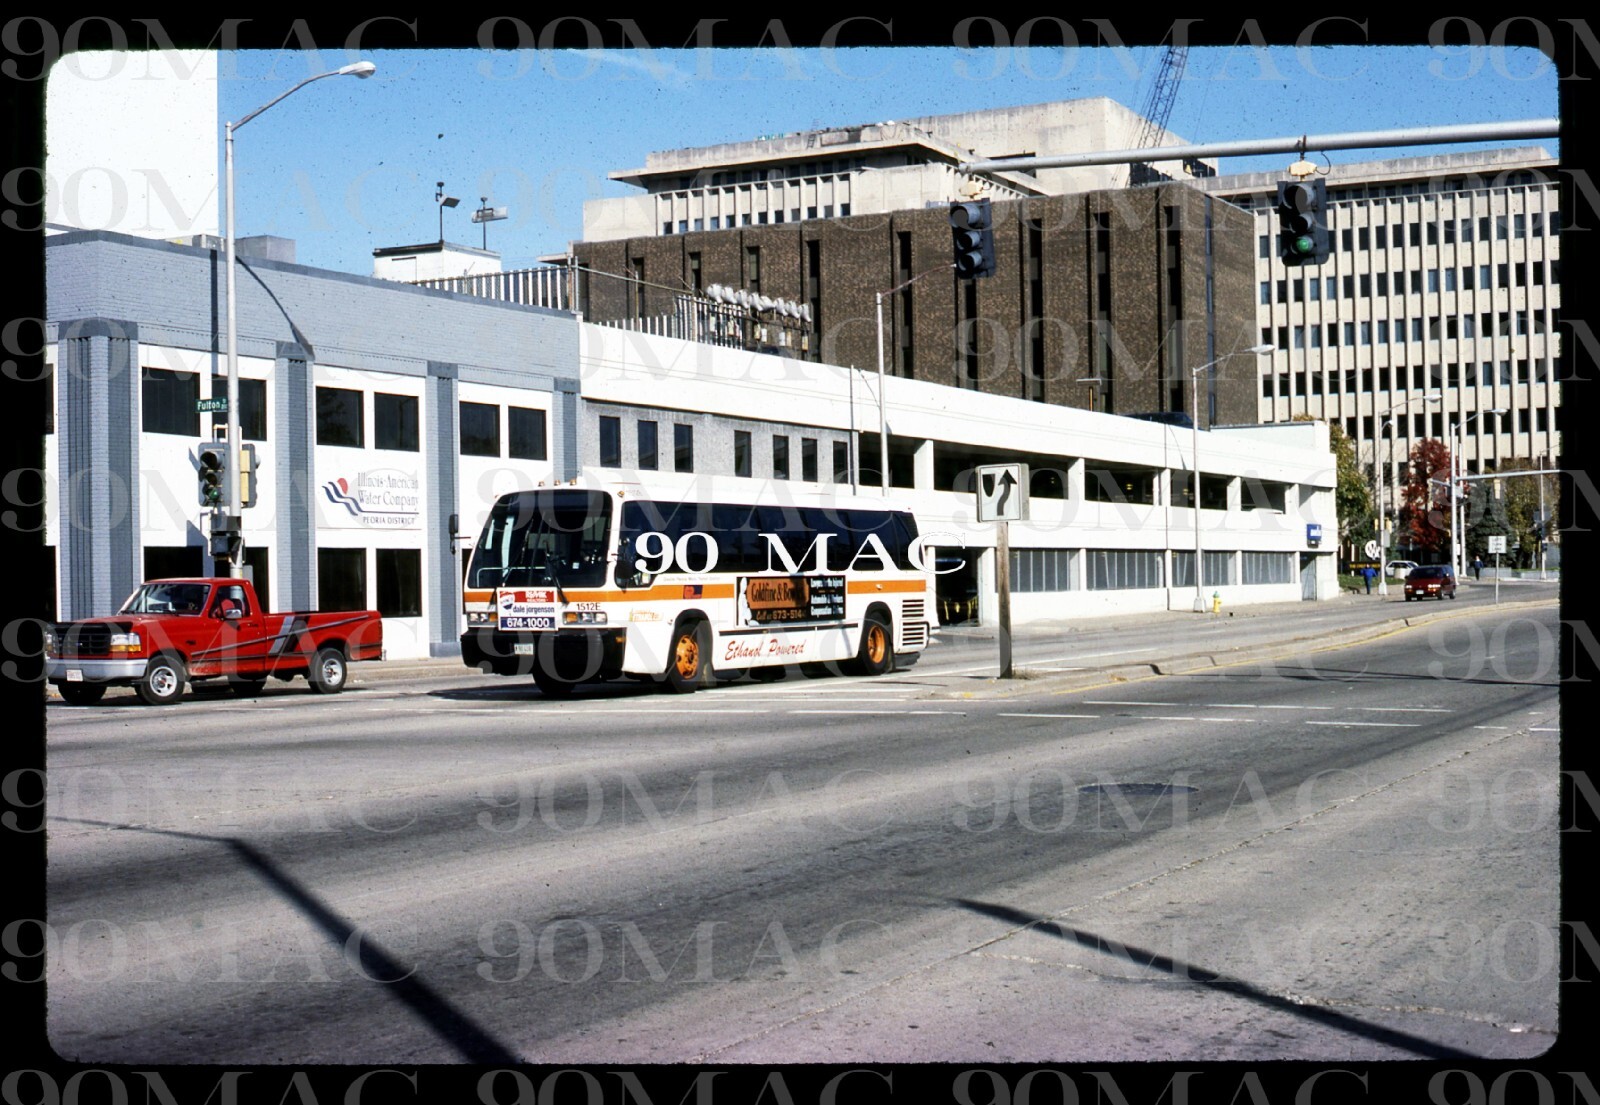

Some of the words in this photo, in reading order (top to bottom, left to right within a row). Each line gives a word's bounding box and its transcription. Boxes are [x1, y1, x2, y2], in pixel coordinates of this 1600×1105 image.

[197, 401, 221, 410] Fulton
[358, 490, 381, 505] Water
[382, 491, 419, 512] Company
[363, 516, 386, 525] PEORIA
[387, 517, 415, 526] DISTRICT
[751, 583, 777, 602] Goldfine
[777, 583, 783, 602] &
[513, 605, 526, 613] dale
[526, 605, 555, 614] jorgenson
[576, 602, 602, 611] 1512E
[725, 640, 764, 661] Ethanol
[768, 638, 807, 658] Powered
